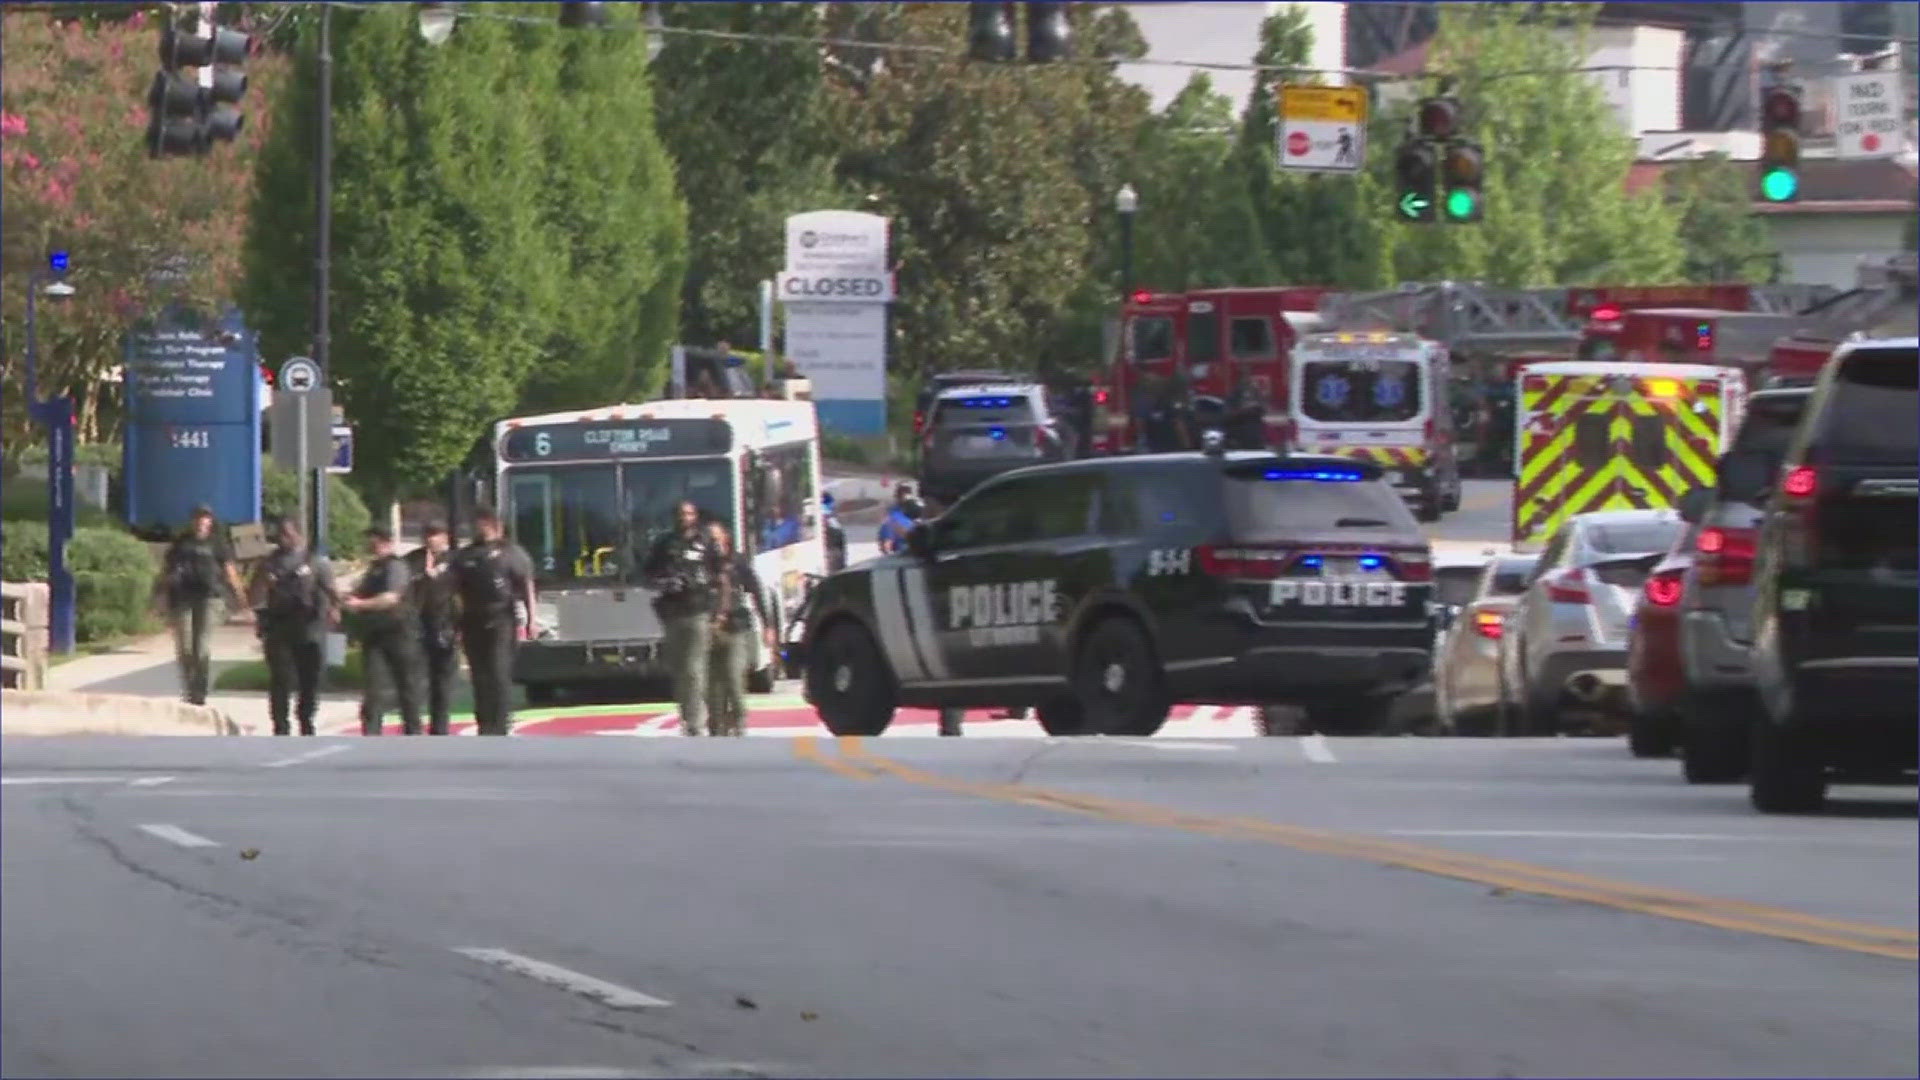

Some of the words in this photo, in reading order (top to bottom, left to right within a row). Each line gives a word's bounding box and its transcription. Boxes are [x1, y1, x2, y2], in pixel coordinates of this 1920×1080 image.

[1850, 82, 1885, 98] NO
[1848, 102, 1890, 116] TURN
[1866, 119, 1899, 133] RED
[784, 277, 884, 296] CLOSED
[185, 345, 226, 355] Program
[535, 432, 551, 456] 6
[584, 429, 635, 444] CLIFTON
[638, 428, 671, 441] ROAD
[1269, 581, 1407, 606] POLICE
[949, 579, 1060, 628] POLICE
